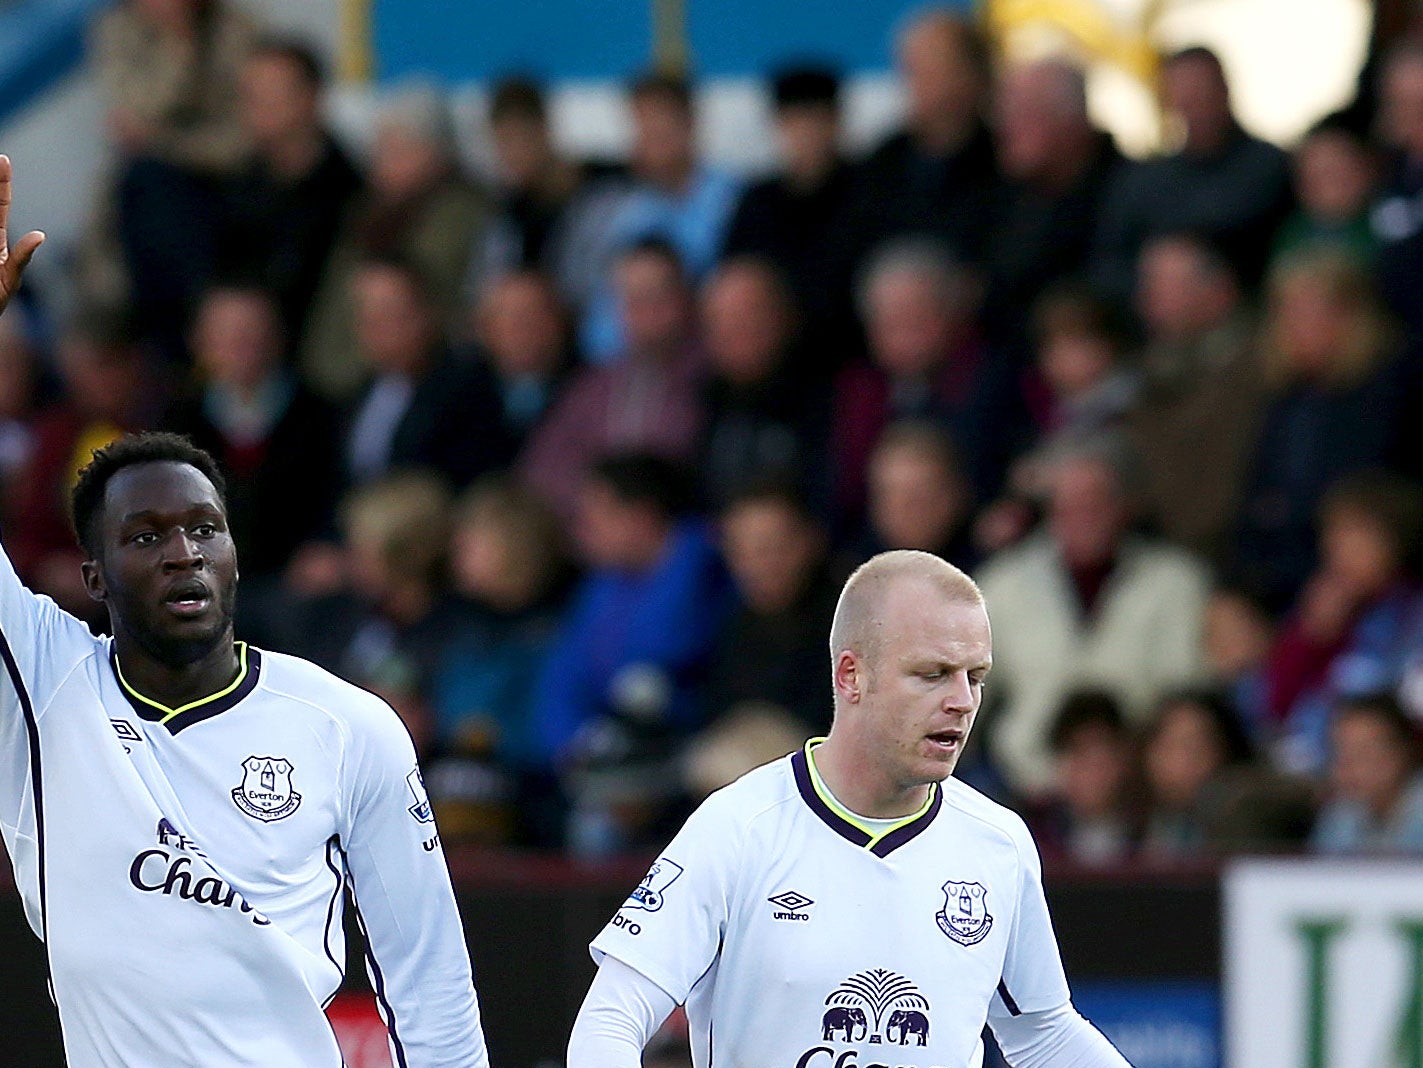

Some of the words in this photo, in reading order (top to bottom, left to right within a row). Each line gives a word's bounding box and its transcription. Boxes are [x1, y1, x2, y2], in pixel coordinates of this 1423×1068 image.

[249, 791, 284, 801] Everton
[130, 850, 271, 925] Chan
[612, 912, 642, 935] bro
[773, 911, 809, 922] umbro
